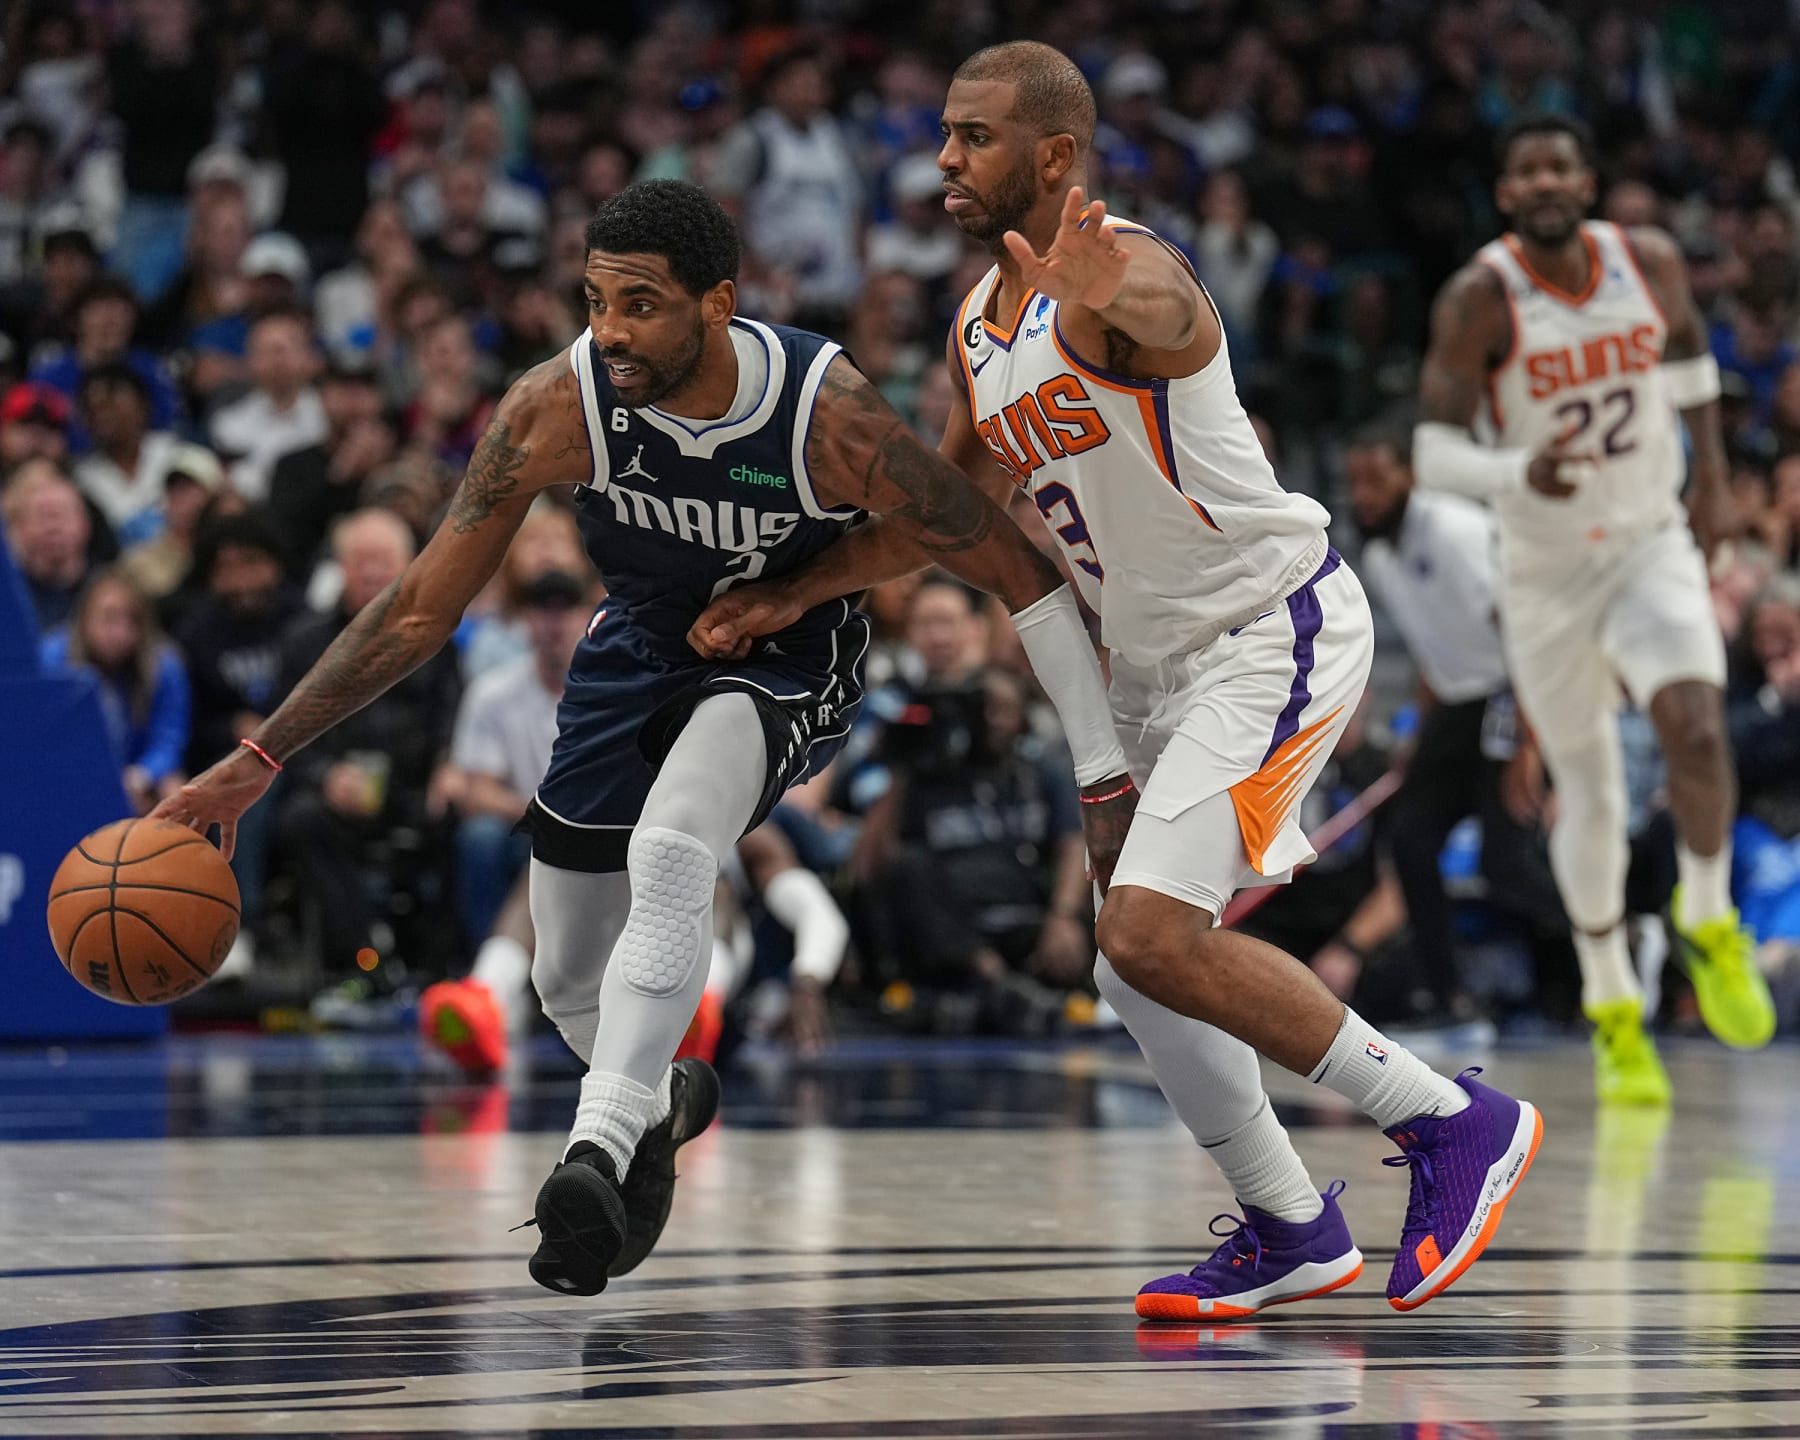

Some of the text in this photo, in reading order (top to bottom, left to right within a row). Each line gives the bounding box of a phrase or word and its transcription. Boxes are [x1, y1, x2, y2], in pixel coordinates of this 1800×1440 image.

[1025, 324, 1048, 340] PayP
[1526, 324, 1661, 399] SUNS
[611, 407, 629, 432] 6
[978, 372, 1112, 489] SUNS
[1555, 387, 1637, 458] 22
[729, 465, 787, 489] chime
[1034, 480, 1105, 586] 3
[708, 551, 767, 602] 2
